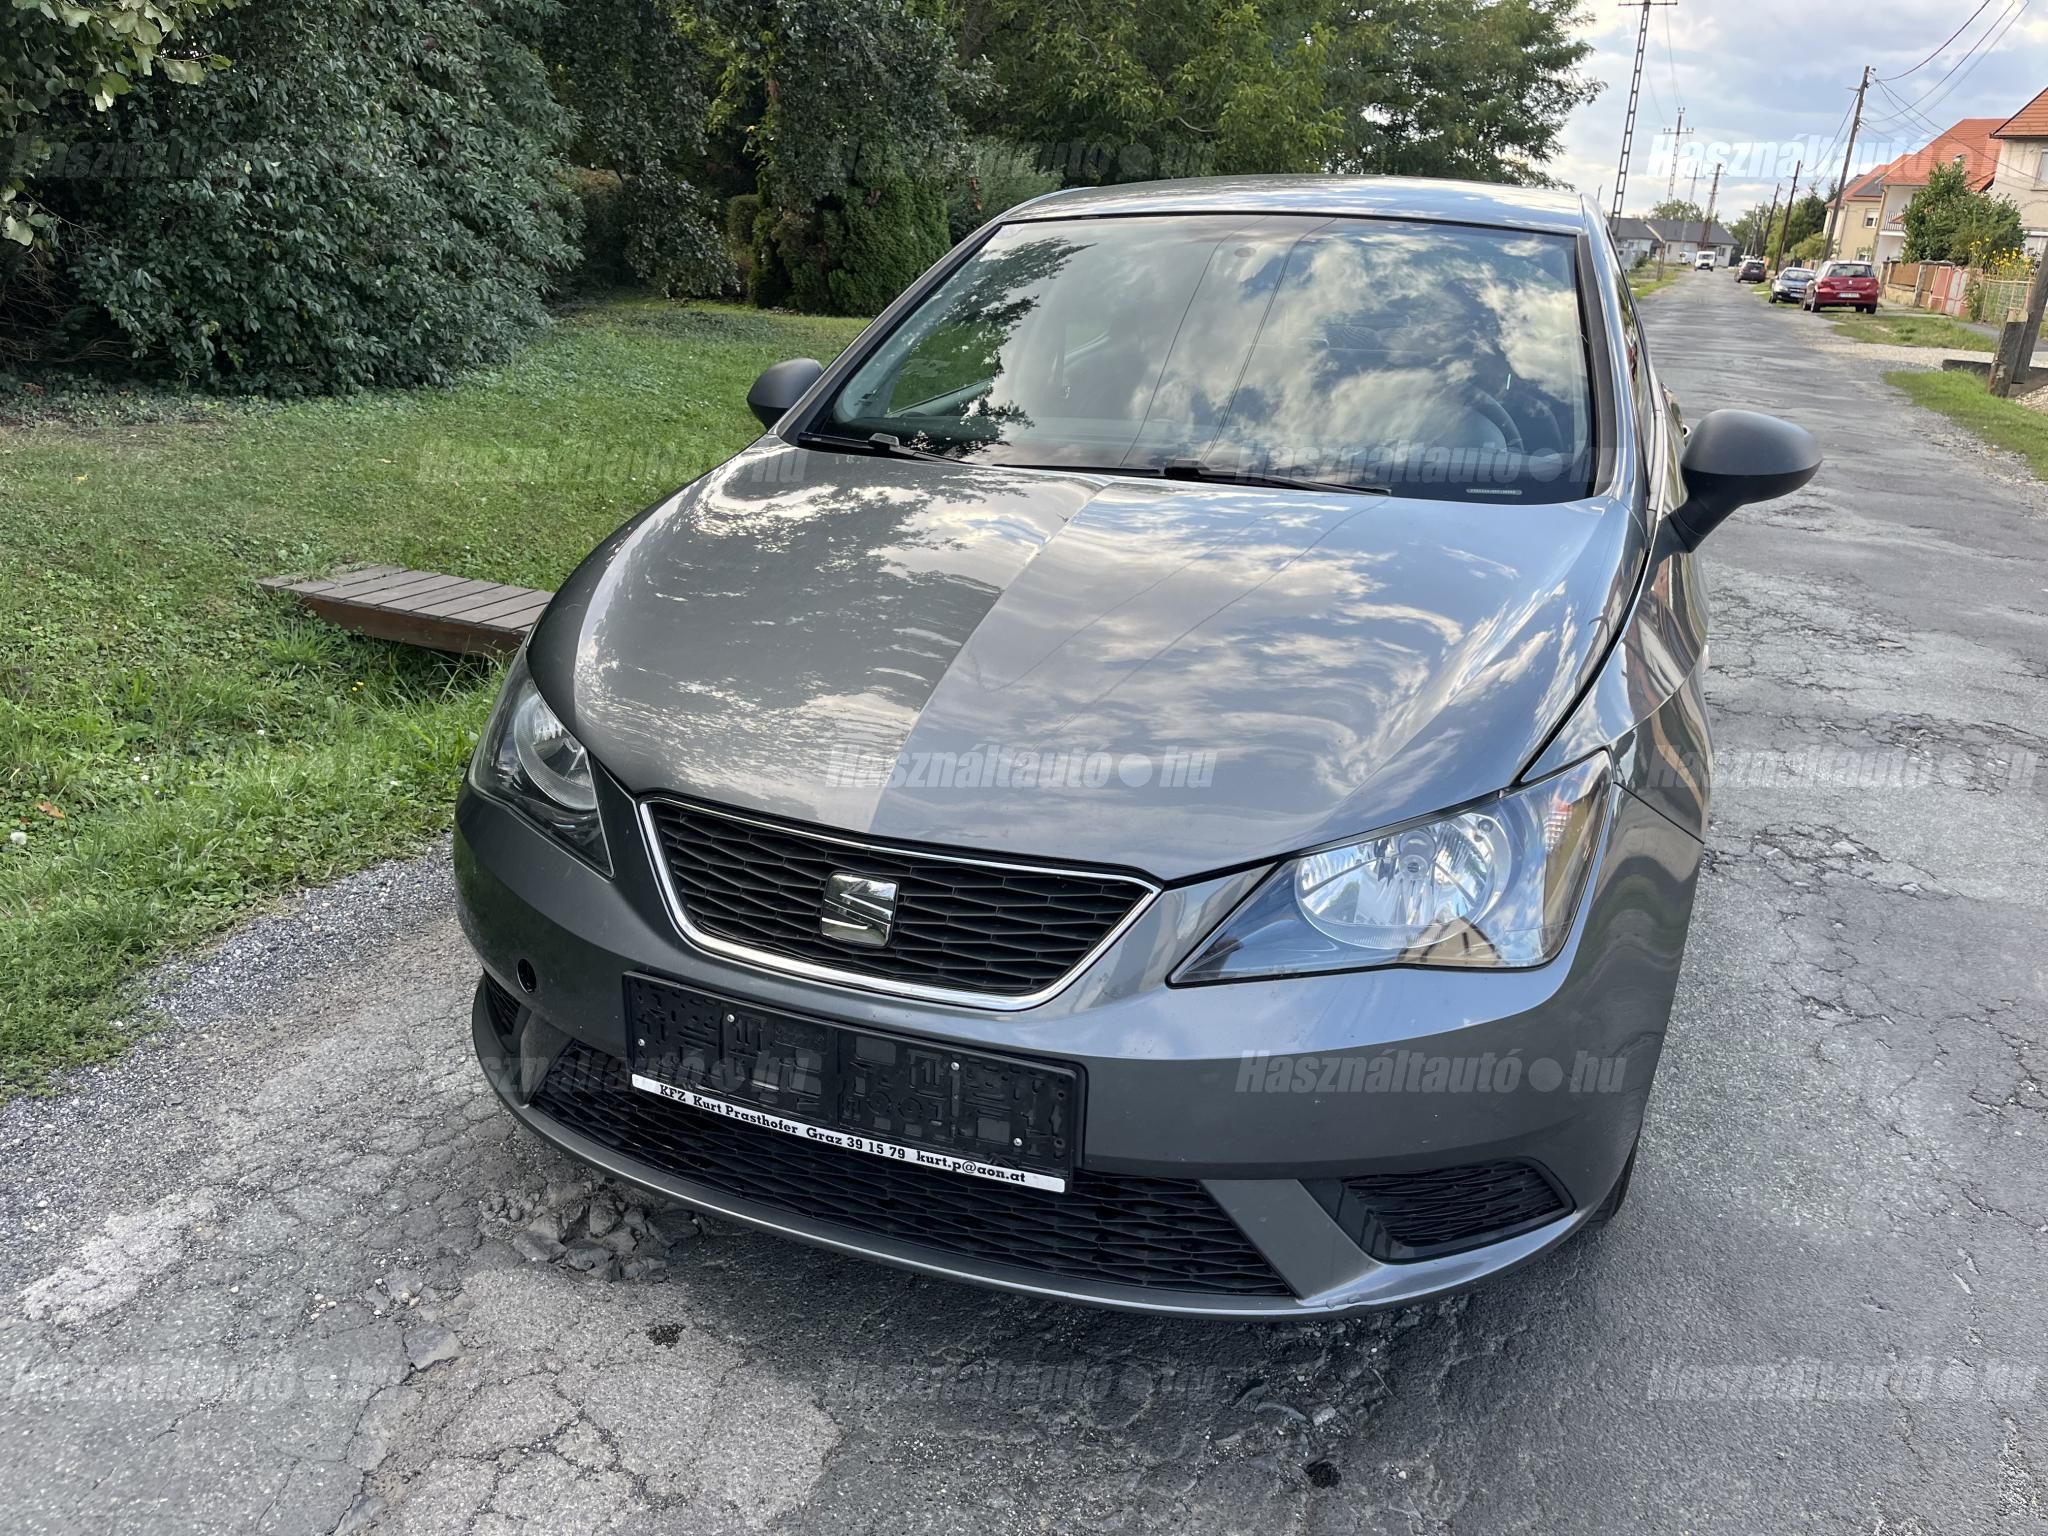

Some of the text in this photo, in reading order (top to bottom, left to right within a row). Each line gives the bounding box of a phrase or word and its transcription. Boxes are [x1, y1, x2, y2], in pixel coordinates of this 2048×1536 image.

[659, 1084, 1026, 1183] KFZ Kurt Prasthofer Graz 39 15 79 kurt.p@aon.at
